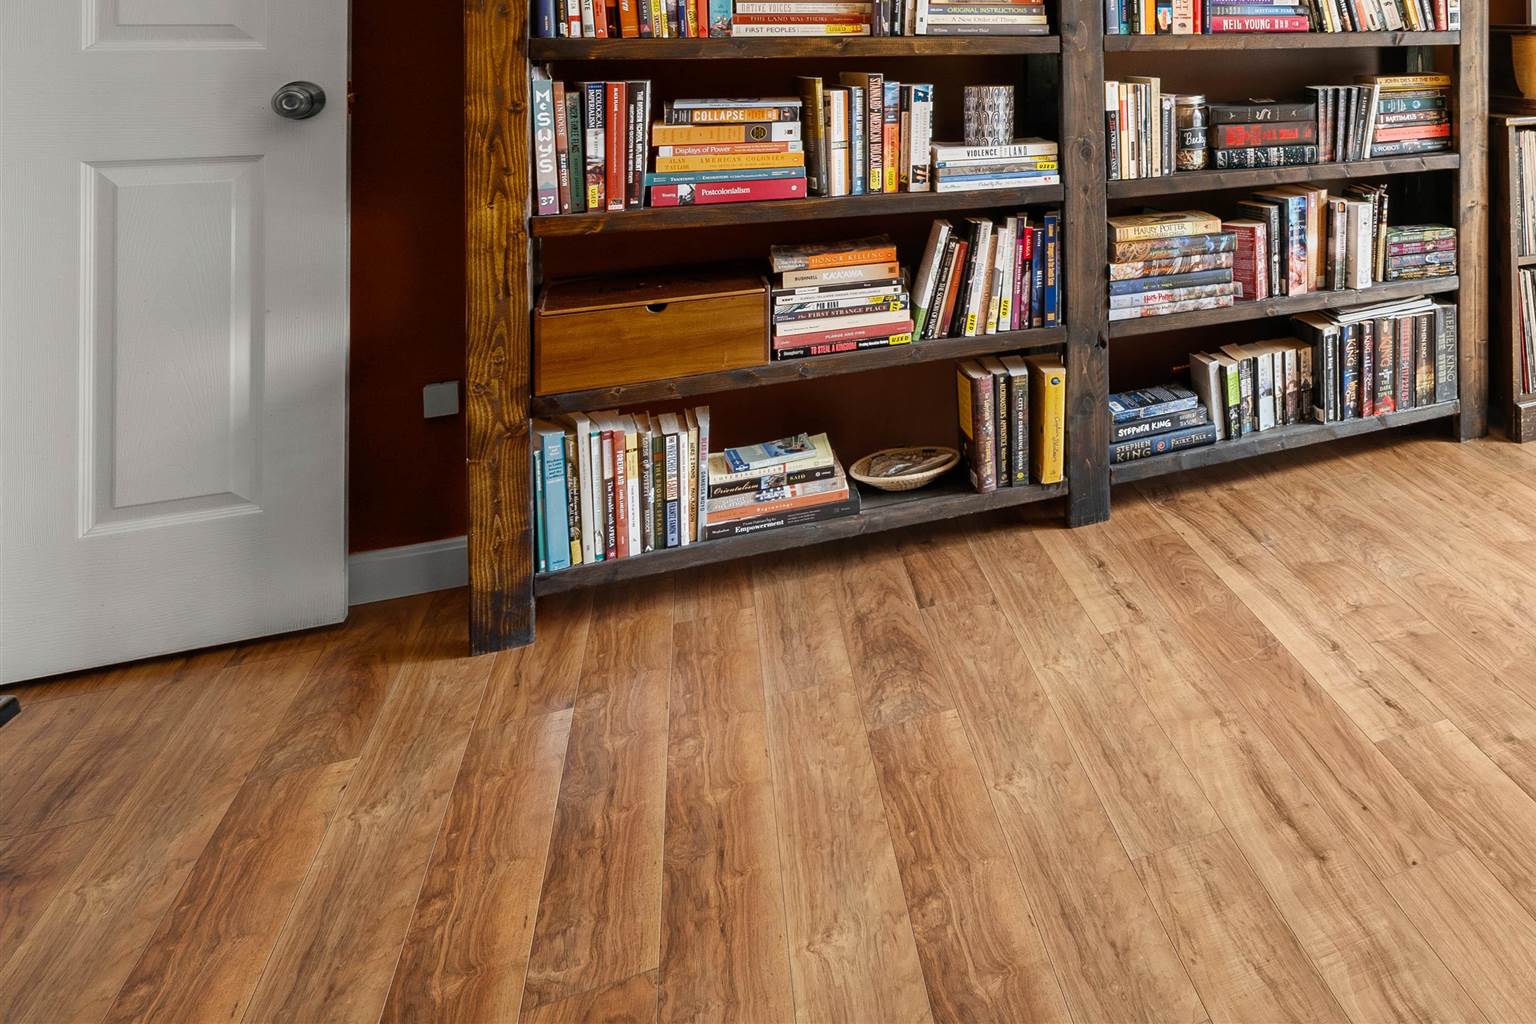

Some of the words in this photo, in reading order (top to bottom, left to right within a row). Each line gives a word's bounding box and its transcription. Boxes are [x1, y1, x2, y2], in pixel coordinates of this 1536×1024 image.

[1223, 19, 1242, 30] NEIL
[1244, 18, 1270, 30] YOUNG
[869, 77, 881, 110] STANNARD
[588, 89, 596, 128] IMPERIALISM
[694, 109, 745, 121] COLLAPSE
[870, 112, 881, 143] AMERICAN
[675, 147, 702, 155] Displays
[966, 148, 997, 157] VIOLENCE
[1008, 145, 1028, 154] LAND
[701, 186, 751, 196] Postcolonialism
[1133, 227, 1156, 235] HARRY
[1159, 224, 1186, 232] POTTER
[830, 307, 864, 317] STRANGE
[968, 315, 976, 331] USED
[891, 335, 909, 343] USED
[1346, 338, 1358, 367] KING
[1379, 336, 1392, 368] KING
[1446, 354, 1455, 382] KING
[1118, 424, 1150, 437] STEPHEN
[1151, 419, 1172, 431] KING
[1116, 440, 1151, 453] STEPHEN
[1116, 448, 1151, 462] KING
[713, 481, 759, 495] Orientalism
[790, 473, 806, 481] SAID
[735, 519, 784, 533] Empowerment
